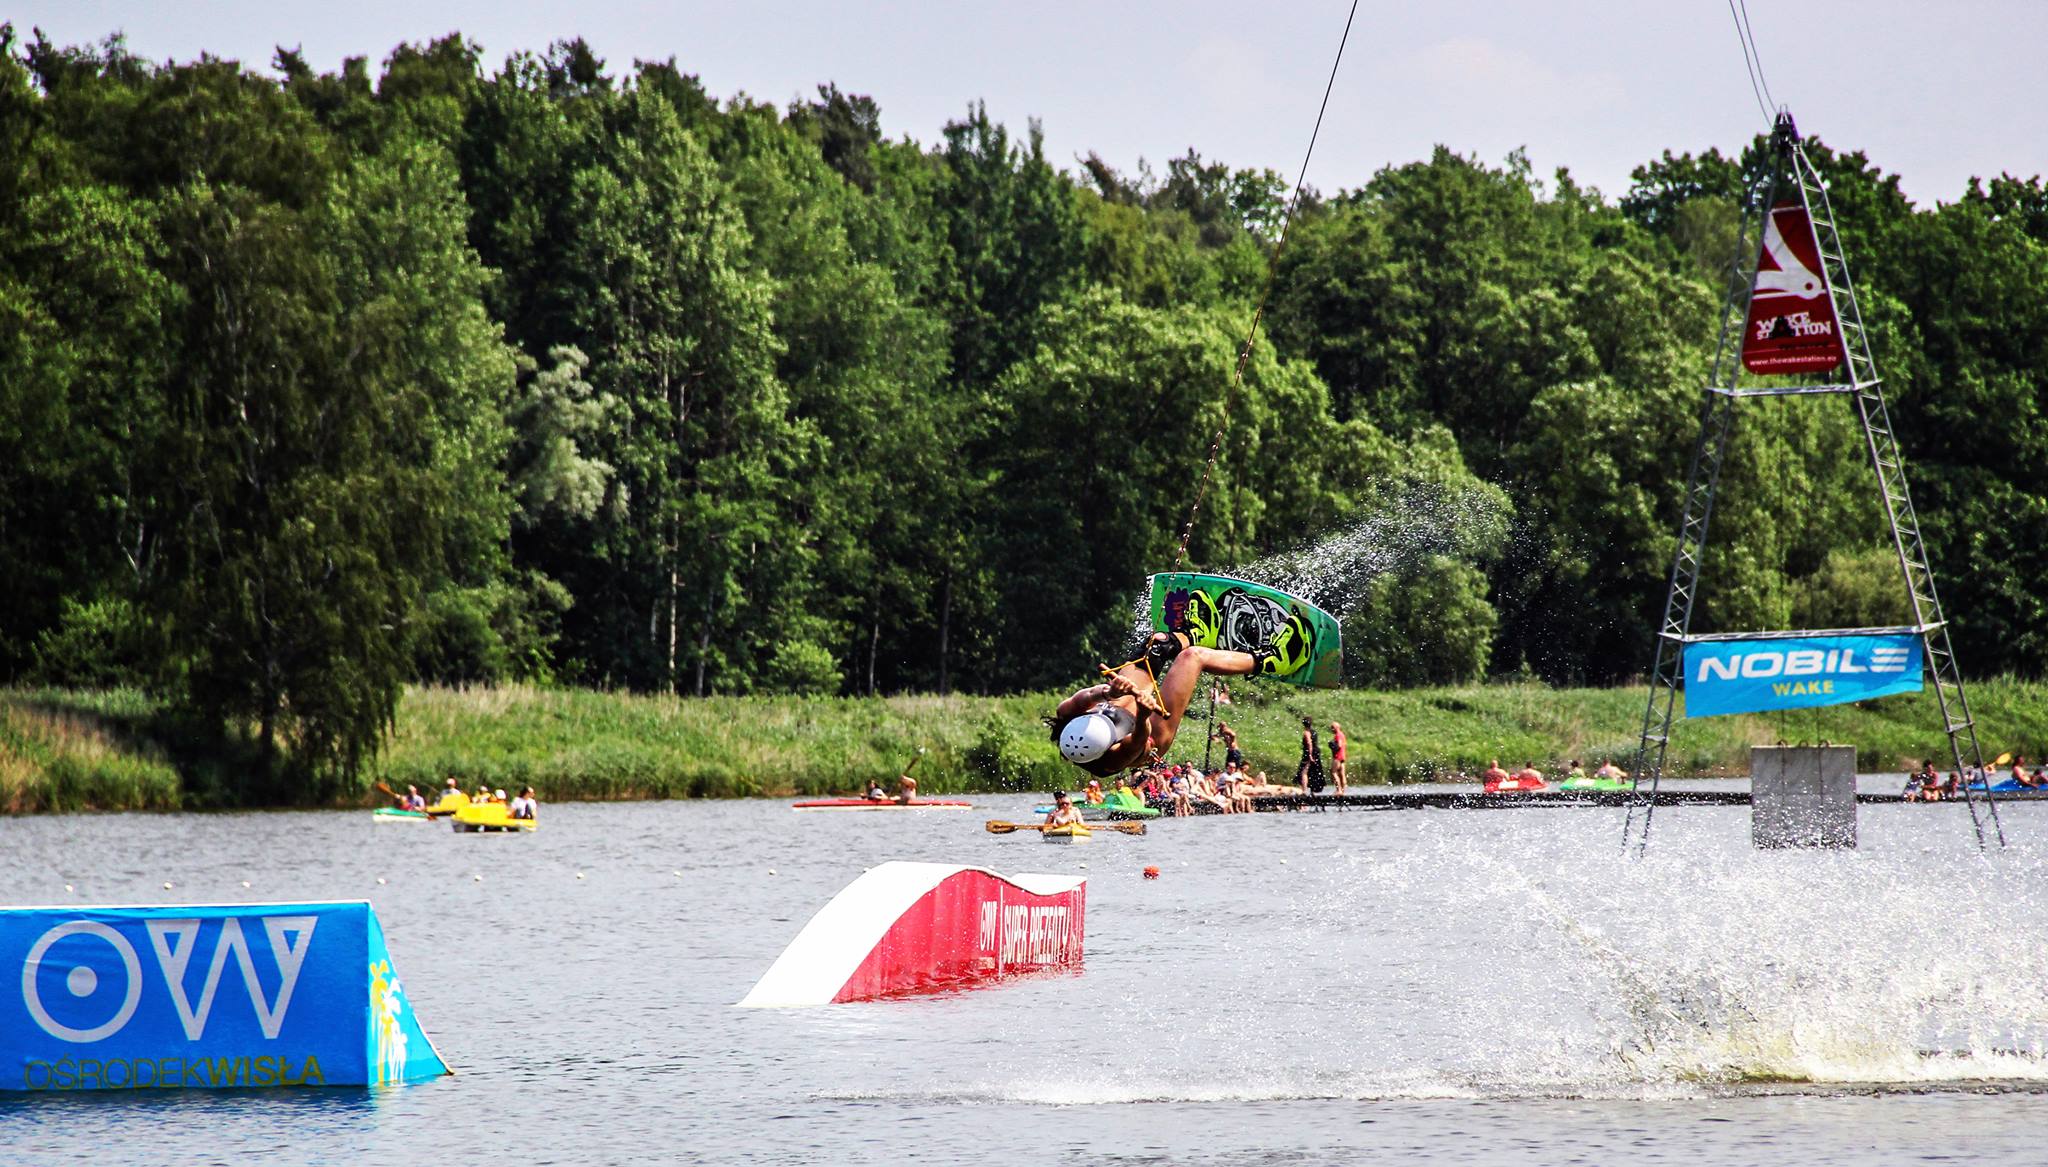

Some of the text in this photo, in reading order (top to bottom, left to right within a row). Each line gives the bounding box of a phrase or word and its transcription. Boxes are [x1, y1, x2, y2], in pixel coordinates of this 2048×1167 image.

[1697, 648, 1909, 682] NOBILE
[1772, 680, 1834, 697] WAKE
[1003, 905, 1028, 964] SUPER
[22, 917, 318, 1043] OW
